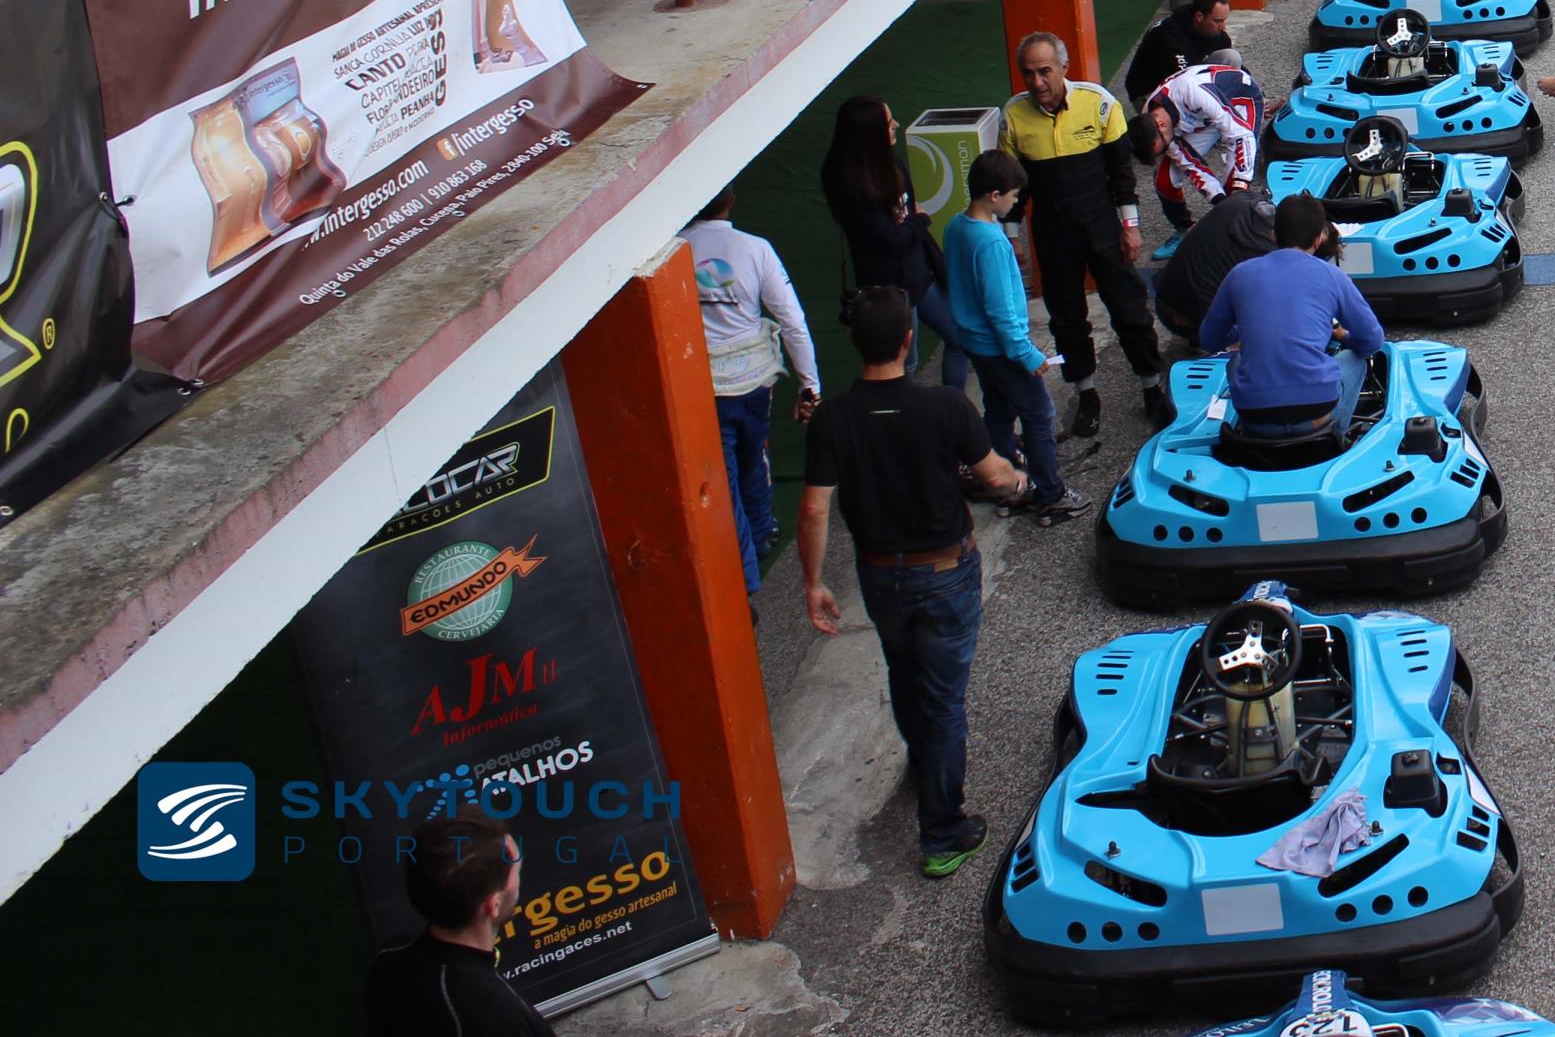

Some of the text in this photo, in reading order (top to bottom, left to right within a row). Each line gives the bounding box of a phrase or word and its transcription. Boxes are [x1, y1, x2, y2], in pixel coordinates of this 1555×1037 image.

[345, 52, 406, 91] CANTO
[300, 277, 340, 305] Quinta
[337, 267, 353, 284] do
[350, 252, 378, 278] Vale
[375, 240, 396, 261] das
[391, 223, 425, 247] Rolas,
[502, 141, 548, 174] 2840-100
[363, 223, 384, 242] 212
[383, 211, 403, 232] 248
[402, 198, 424, 219] 600
[428, 182, 451, 201] 910
[449, 170, 469, 191] 863
[467, 159, 488, 179] 168
[474, 476, 516, 501] AUTO
[409, 561, 507, 624] EDMUNDO
[414, 544, 492, 585] RESTAURANTE
[438, 608, 505, 640] CERVEJARIA
[410, 647, 538, 736] AJM
[473, 735, 563, 780] pequenos
[482, 740, 594, 795] ATALHOS
[498, 851, 672, 942] rgesso
[533, 881, 677, 950] a magia do gesso artesanal
